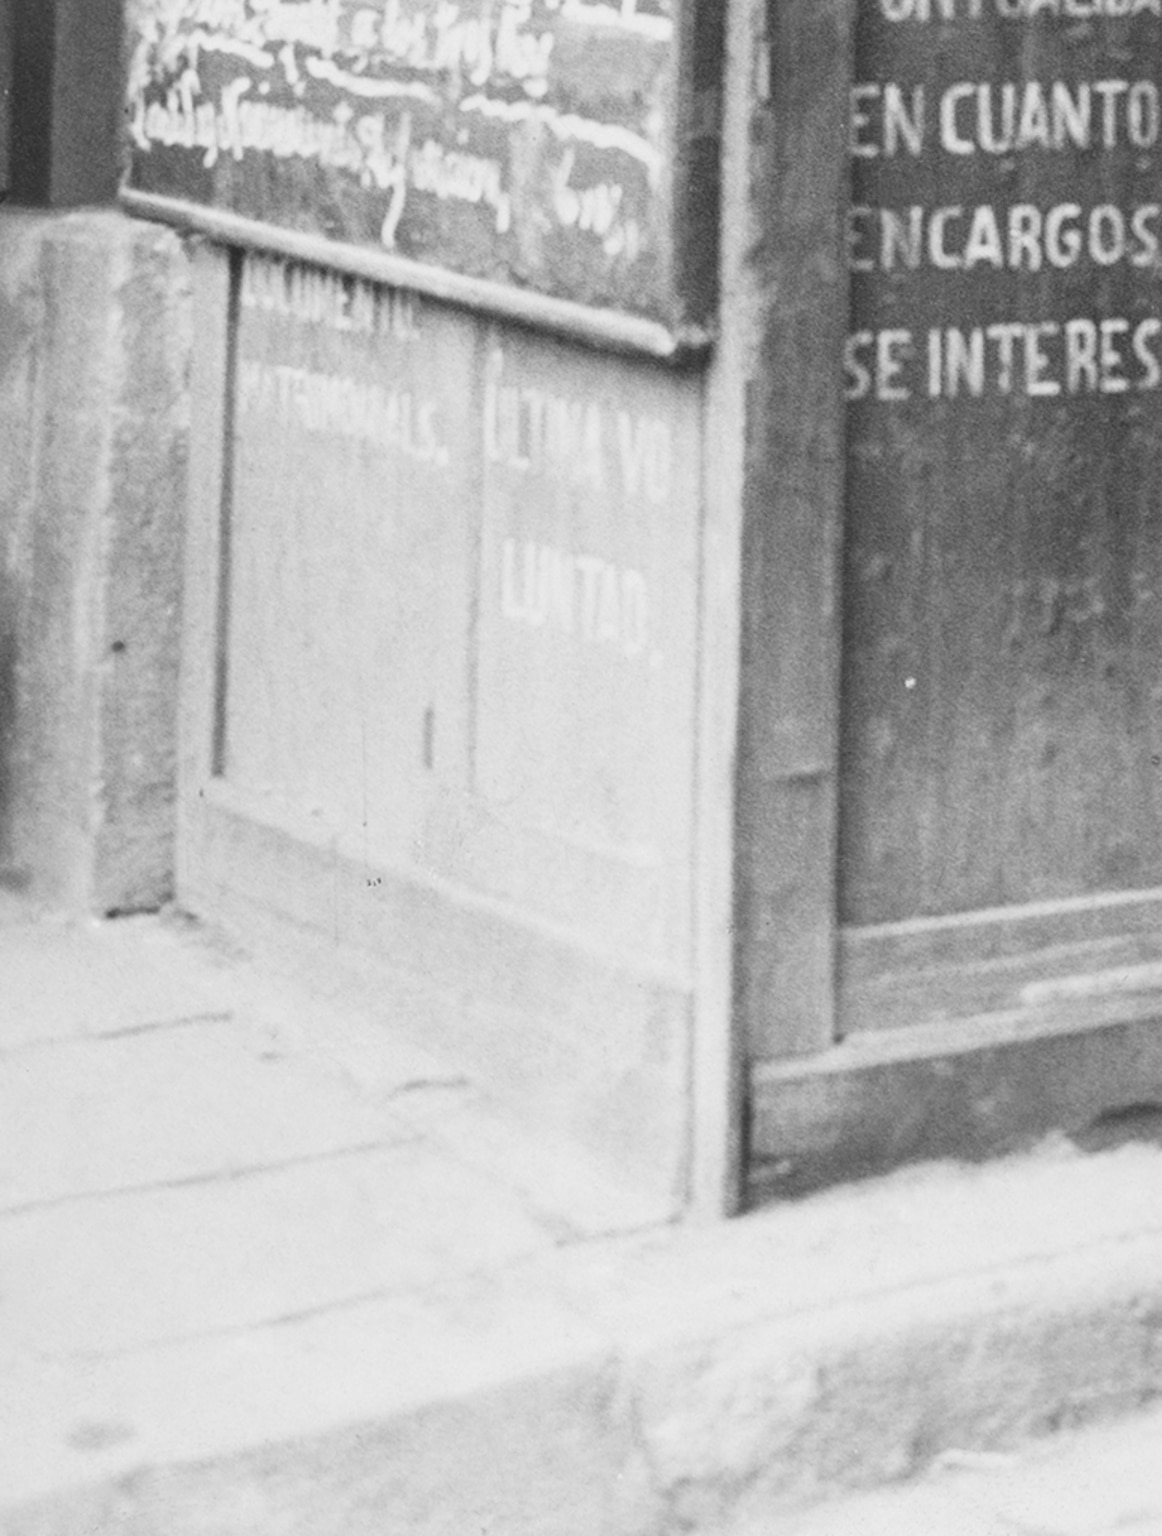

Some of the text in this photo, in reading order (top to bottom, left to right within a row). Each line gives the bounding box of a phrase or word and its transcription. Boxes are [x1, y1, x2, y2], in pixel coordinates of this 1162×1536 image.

[849, 81, 927, 157] EN
[844, 202, 1162, 271] ENCARGOS
[842, 328, 913, 401] SE
